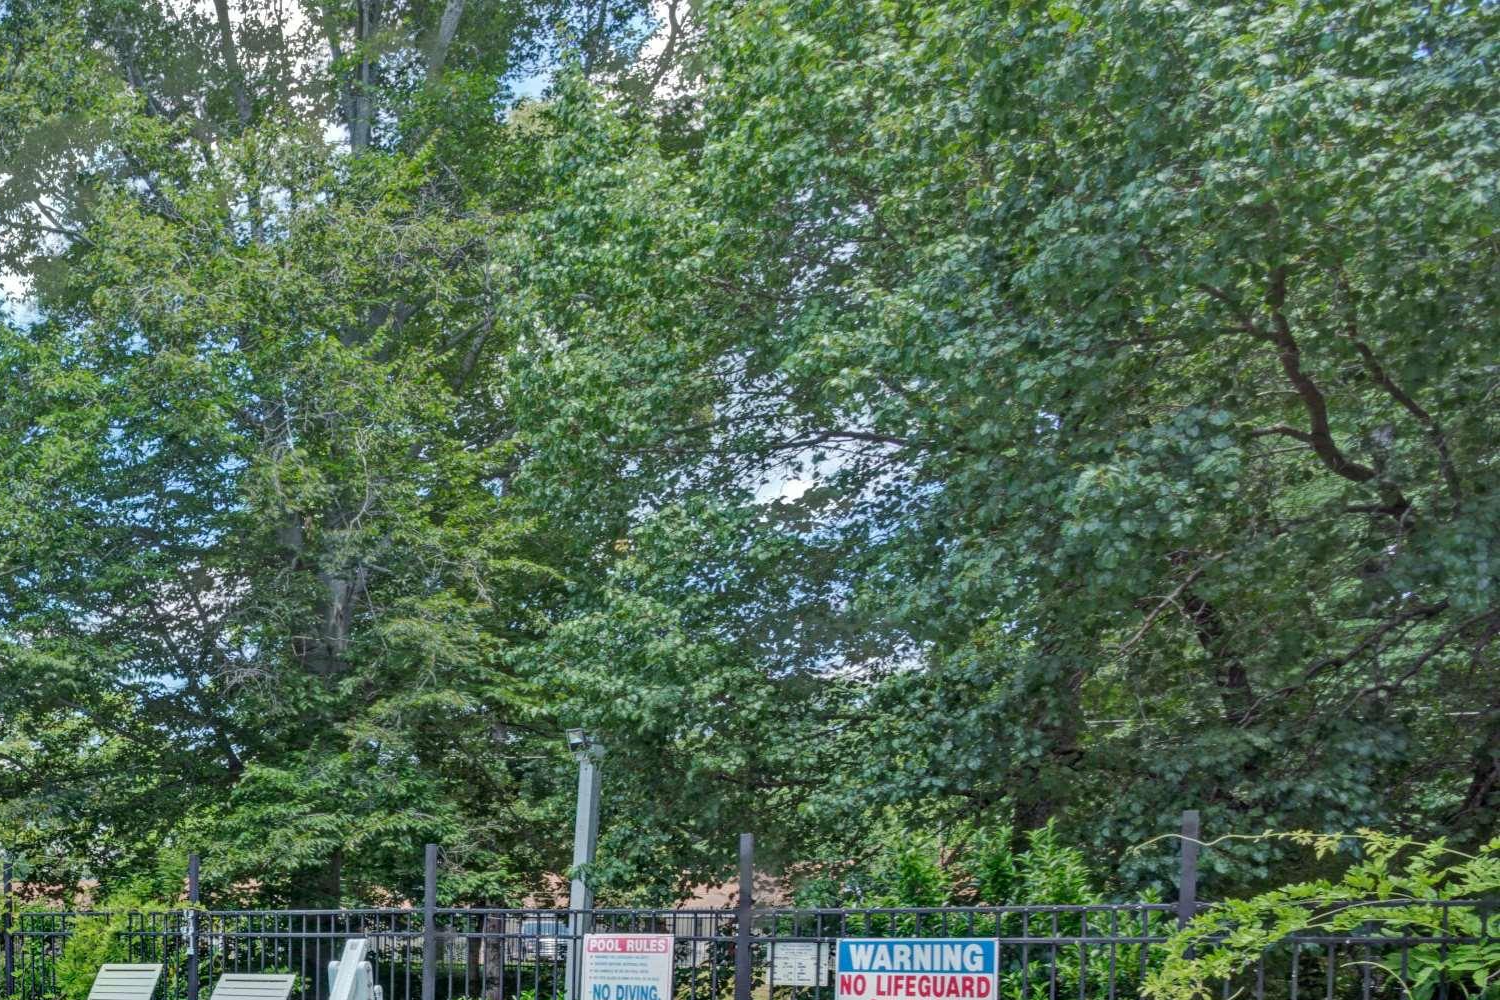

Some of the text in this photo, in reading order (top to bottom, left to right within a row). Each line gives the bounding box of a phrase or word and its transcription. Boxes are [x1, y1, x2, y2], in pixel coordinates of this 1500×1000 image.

[589, 939, 666, 952] POOL RULES
[849, 943, 984, 972] WARNING
[592, 983, 611, 1000] NO
[840, 974, 991, 998] NO LIFEGUARD
